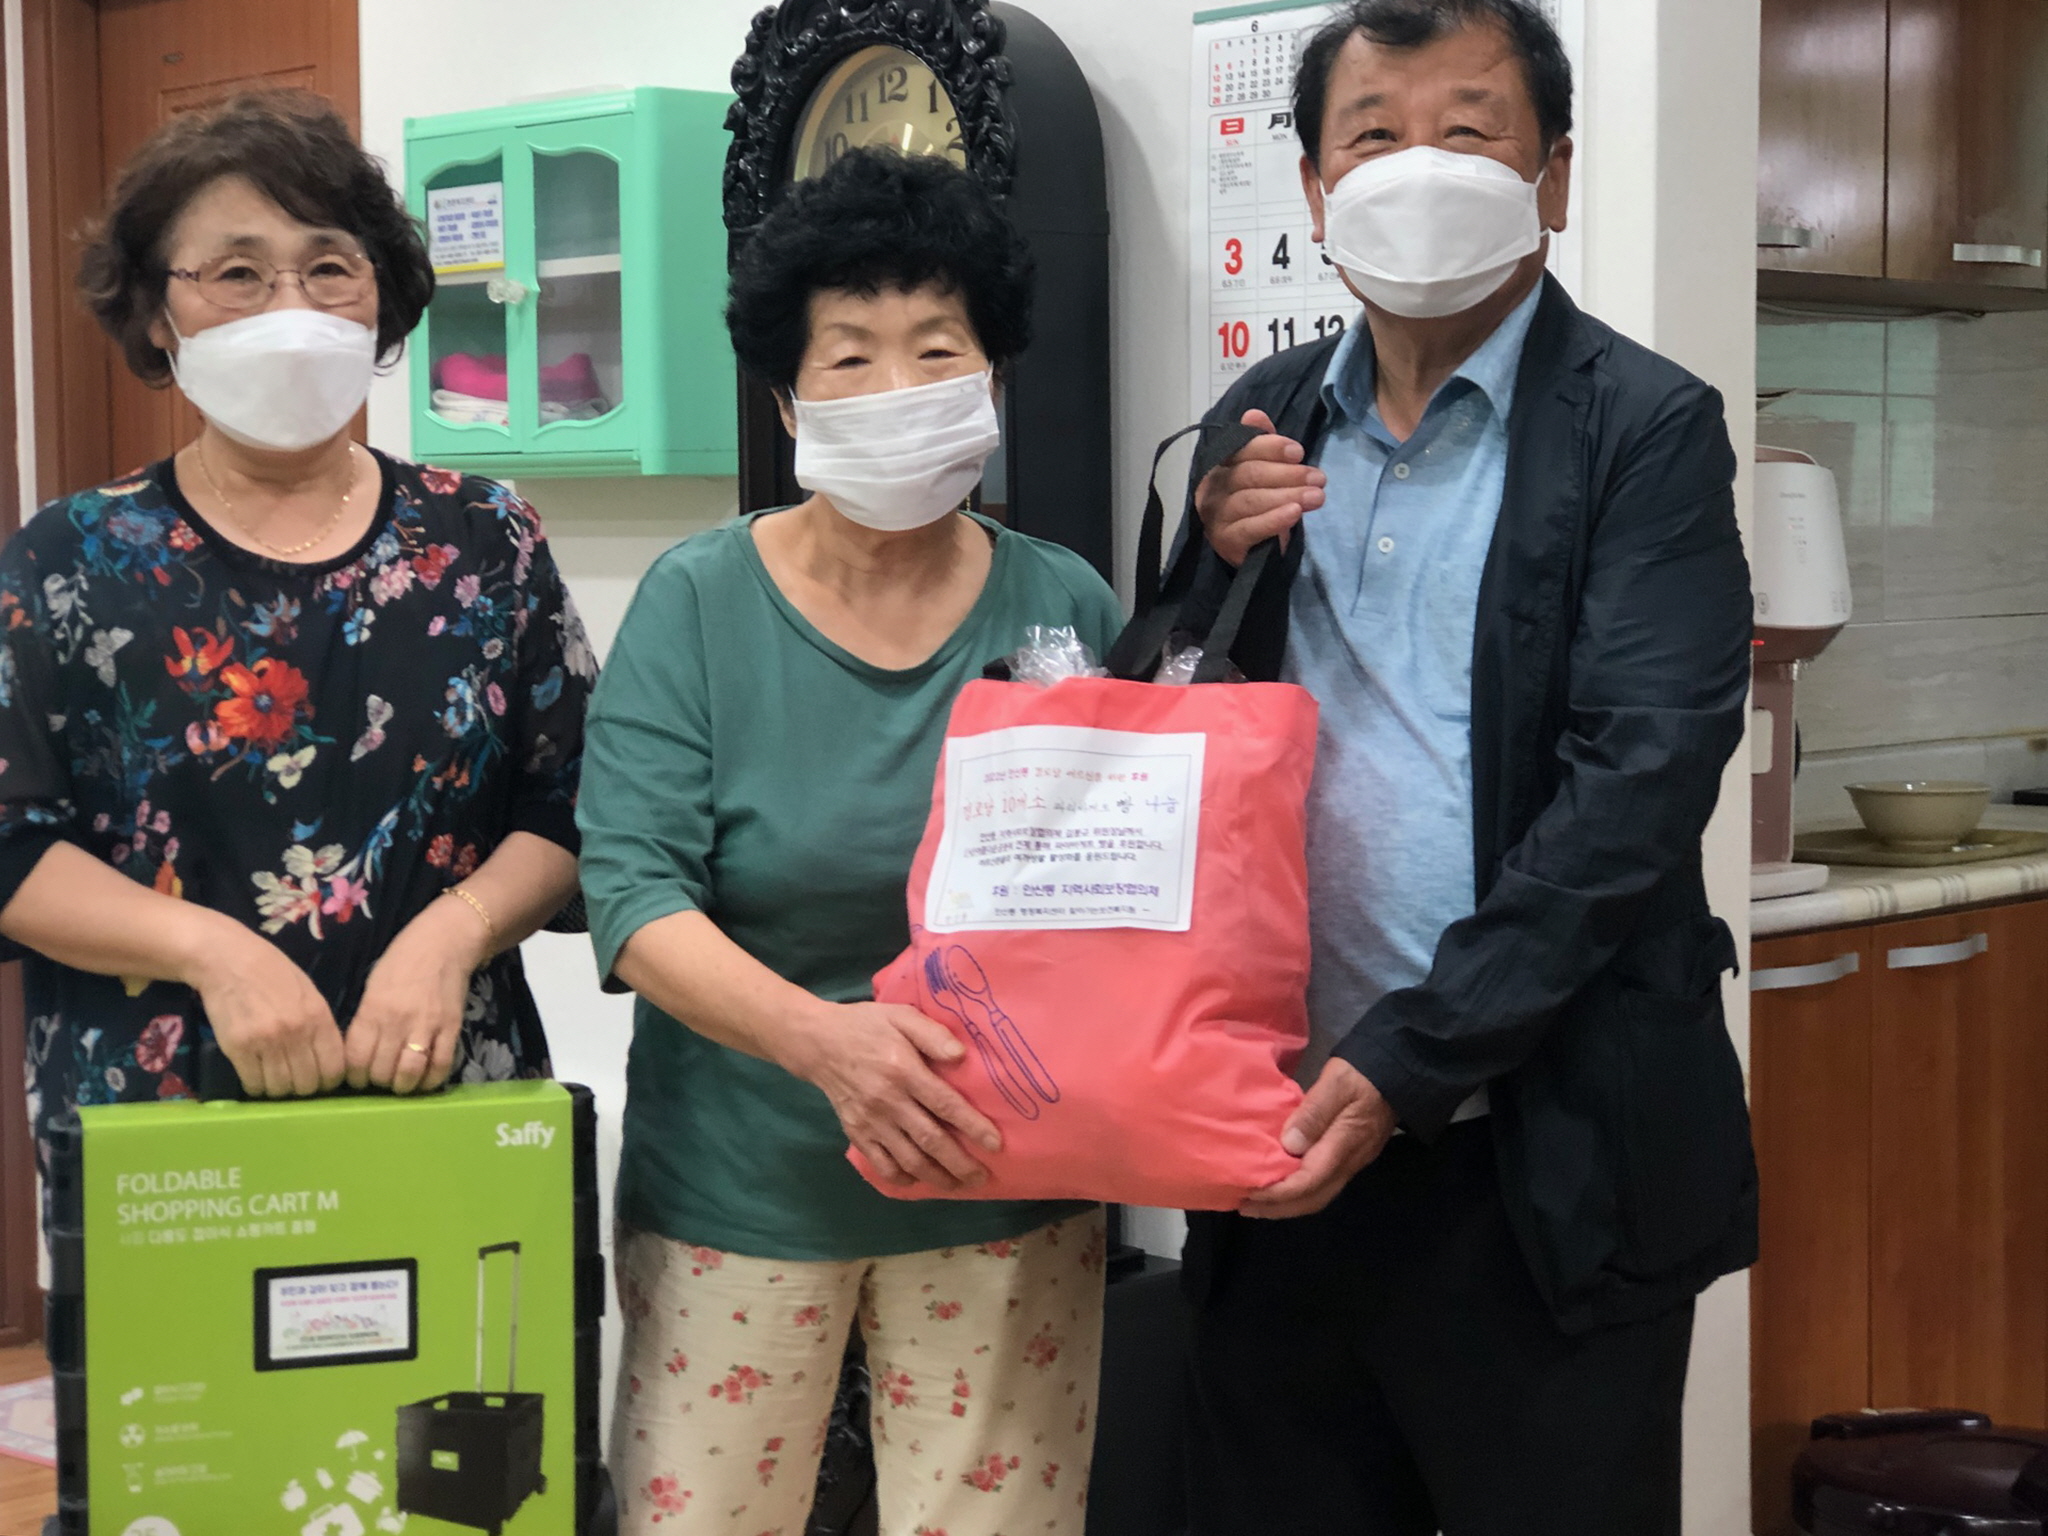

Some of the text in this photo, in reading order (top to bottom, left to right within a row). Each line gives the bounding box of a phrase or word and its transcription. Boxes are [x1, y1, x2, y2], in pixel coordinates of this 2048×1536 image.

[1251, 20, 1259, 33] 6
[1276, 54, 1284, 63] 10
[878, 66, 909, 104] 12
[1225, 72, 1234, 81] 13
[1238, 71, 1245, 79] 14
[1250, 69, 1258, 77] 15
[1263, 67, 1271, 76] 16
[1225, 83, 1234, 92] 20
[1238, 81, 1246, 90] 21
[1250, 80, 1258, 89] 22
[1262, 78, 1271, 87] 23
[1275, 77, 1283, 86] 24
[846, 90, 869, 124] 11
[928, 79, 939, 113] 1
[1237, 92, 1246, 101] 28
[1249, 91, 1258, 100] 29
[1262, 89, 1271, 98] 30
[945, 116, 965, 150] 2
[1220, 117, 1244, 135] 日
[1268, 112, 1292, 129] 月
[825, 132, 849, 167] 10
[1225, 139, 1239, 147] SUN
[1271, 133, 1288, 141] MON
[1224, 238, 1243, 275] 3
[1272, 233, 1291, 270] 4
[1218, 320, 1250, 358] 10
[1267, 317, 1295, 354] 11
[495, 1121, 556, 1149] Saffy
[116, 1167, 242, 1195] FOLDABLE
[117, 1190, 340, 1226] SHOPPING CART M
[236, 1220, 286, 1239] 쇼핑카트
